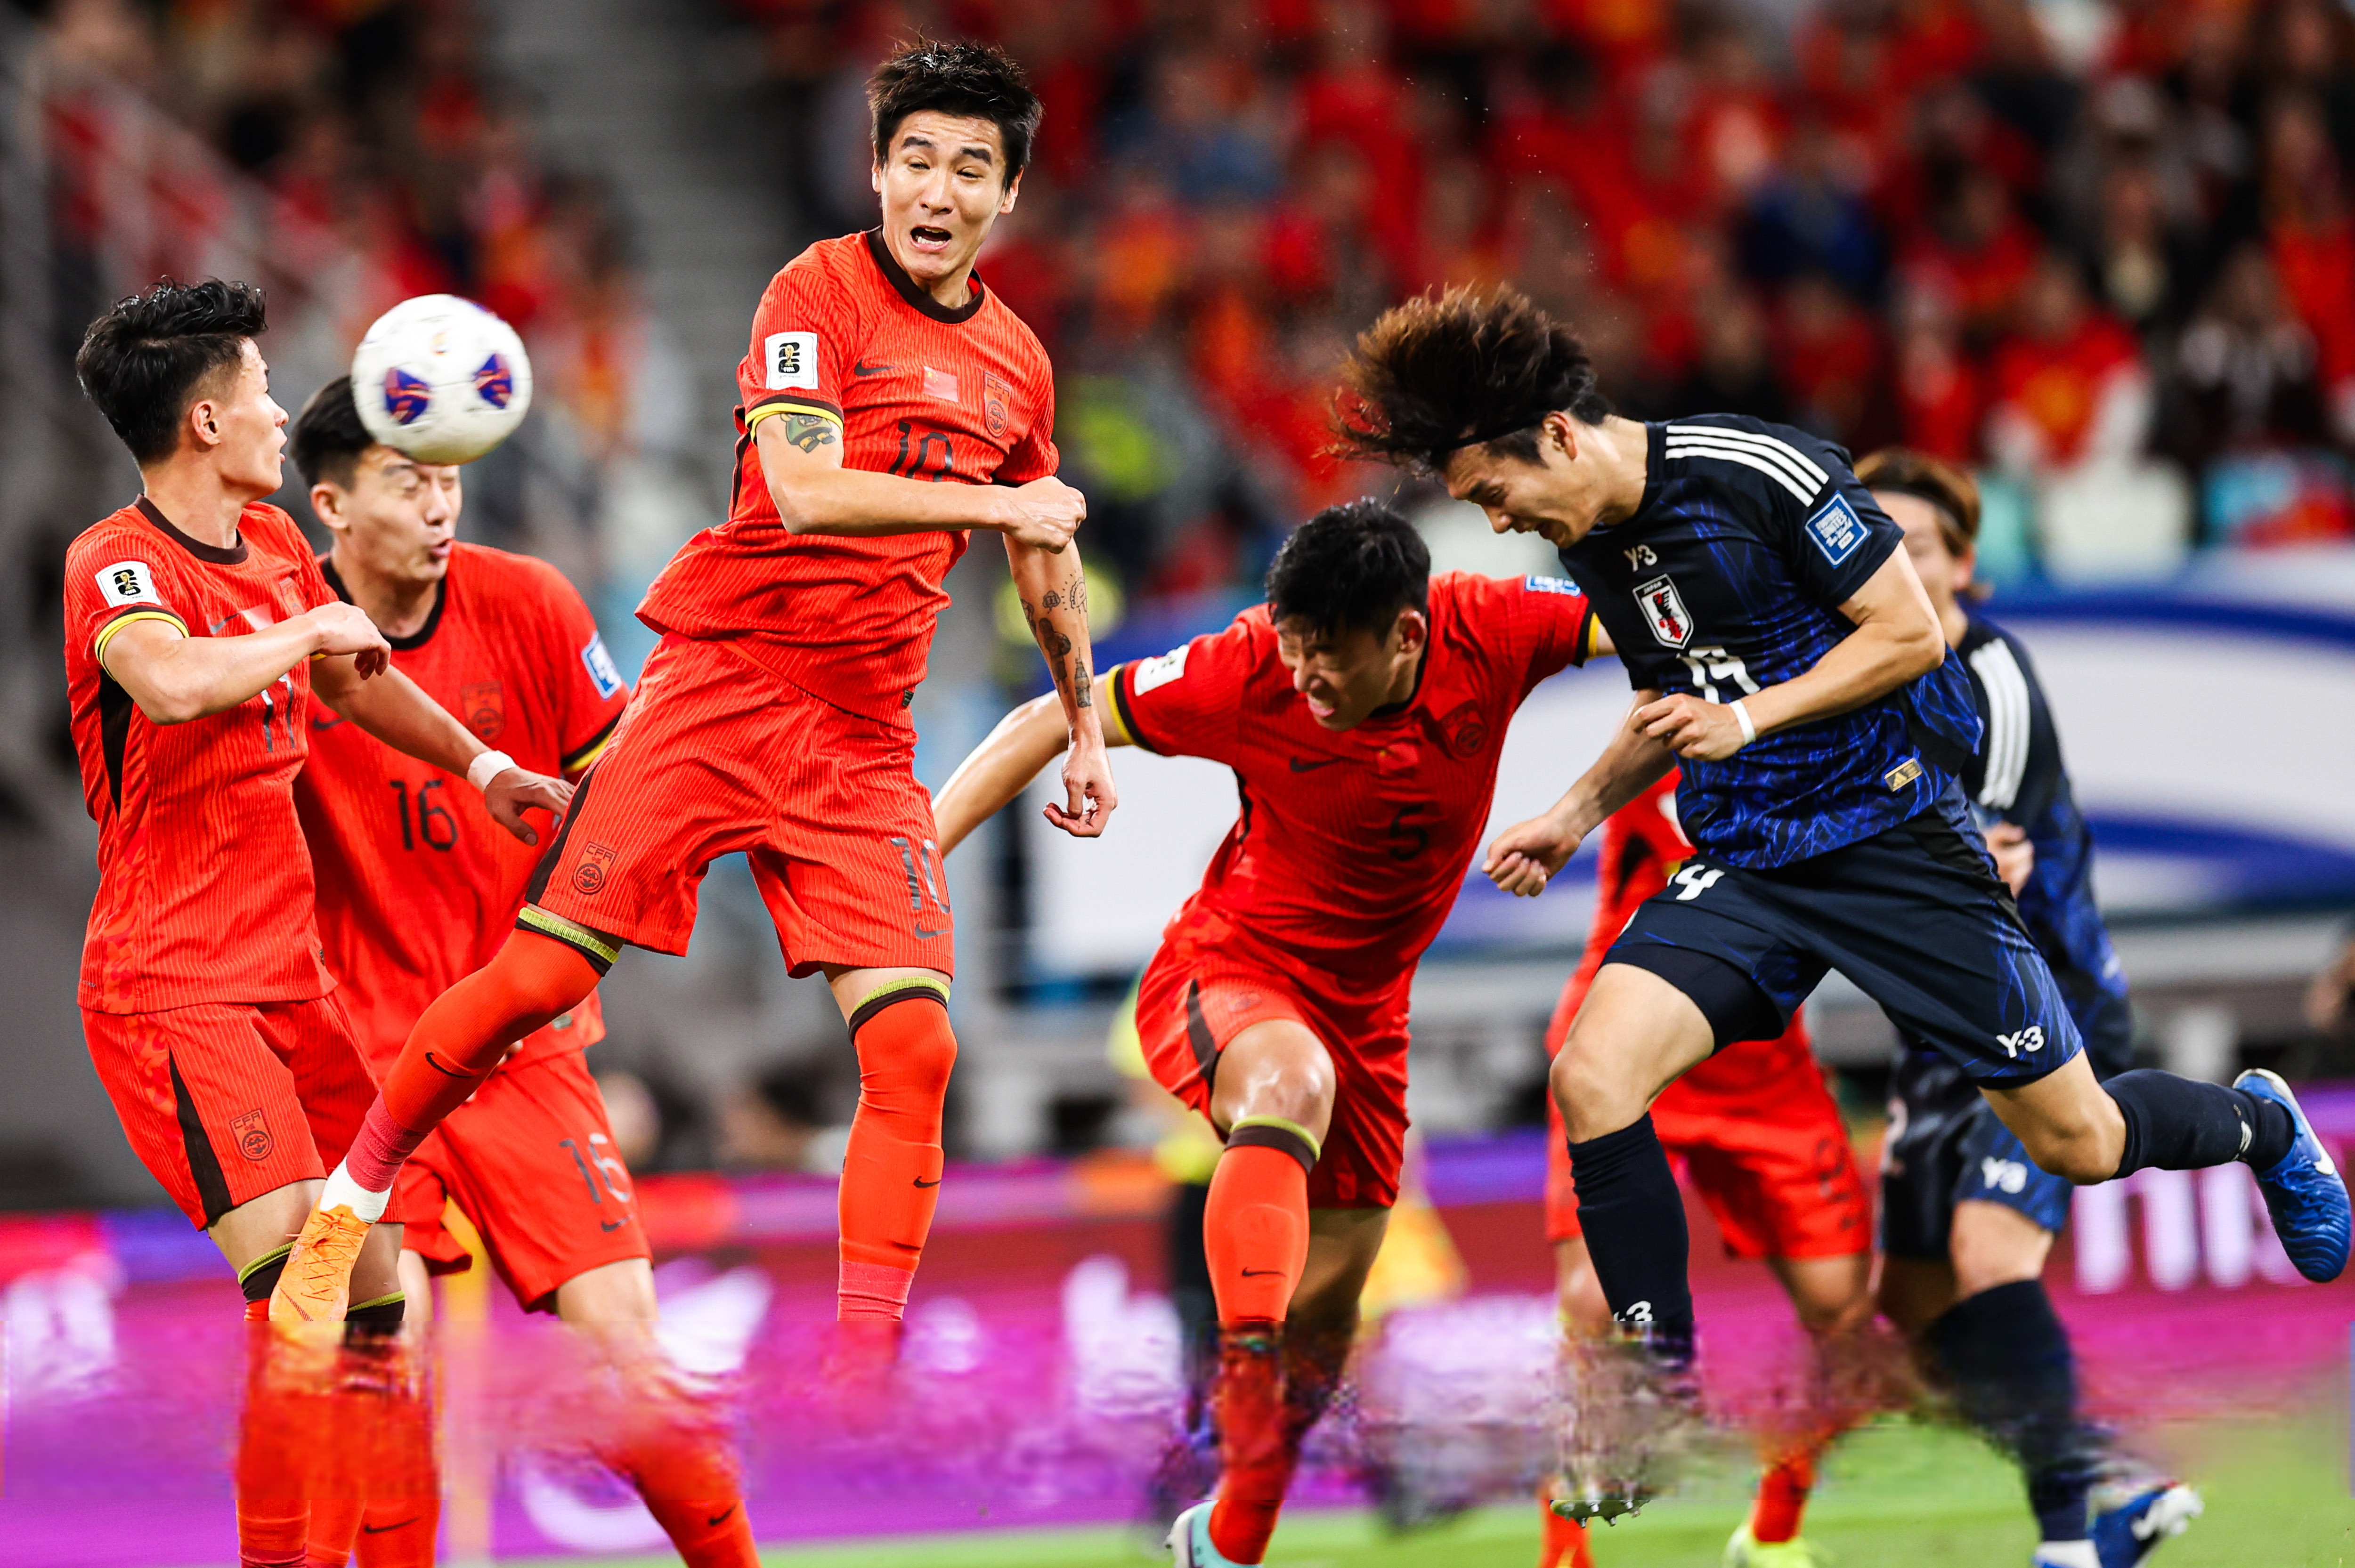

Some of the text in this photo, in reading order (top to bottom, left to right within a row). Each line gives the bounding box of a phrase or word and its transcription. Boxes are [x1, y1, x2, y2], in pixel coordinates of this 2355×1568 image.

[1623, 544, 1657, 572] Y-3
[390, 780, 458, 851] 16
[1390, 804, 1429, 861] 5
[586, 845, 613, 862] CFA
[1996, 1026, 2044, 1059] Y-3
[234, 1112, 261, 1130] CFA
[559, 1132, 629, 1204] 16
